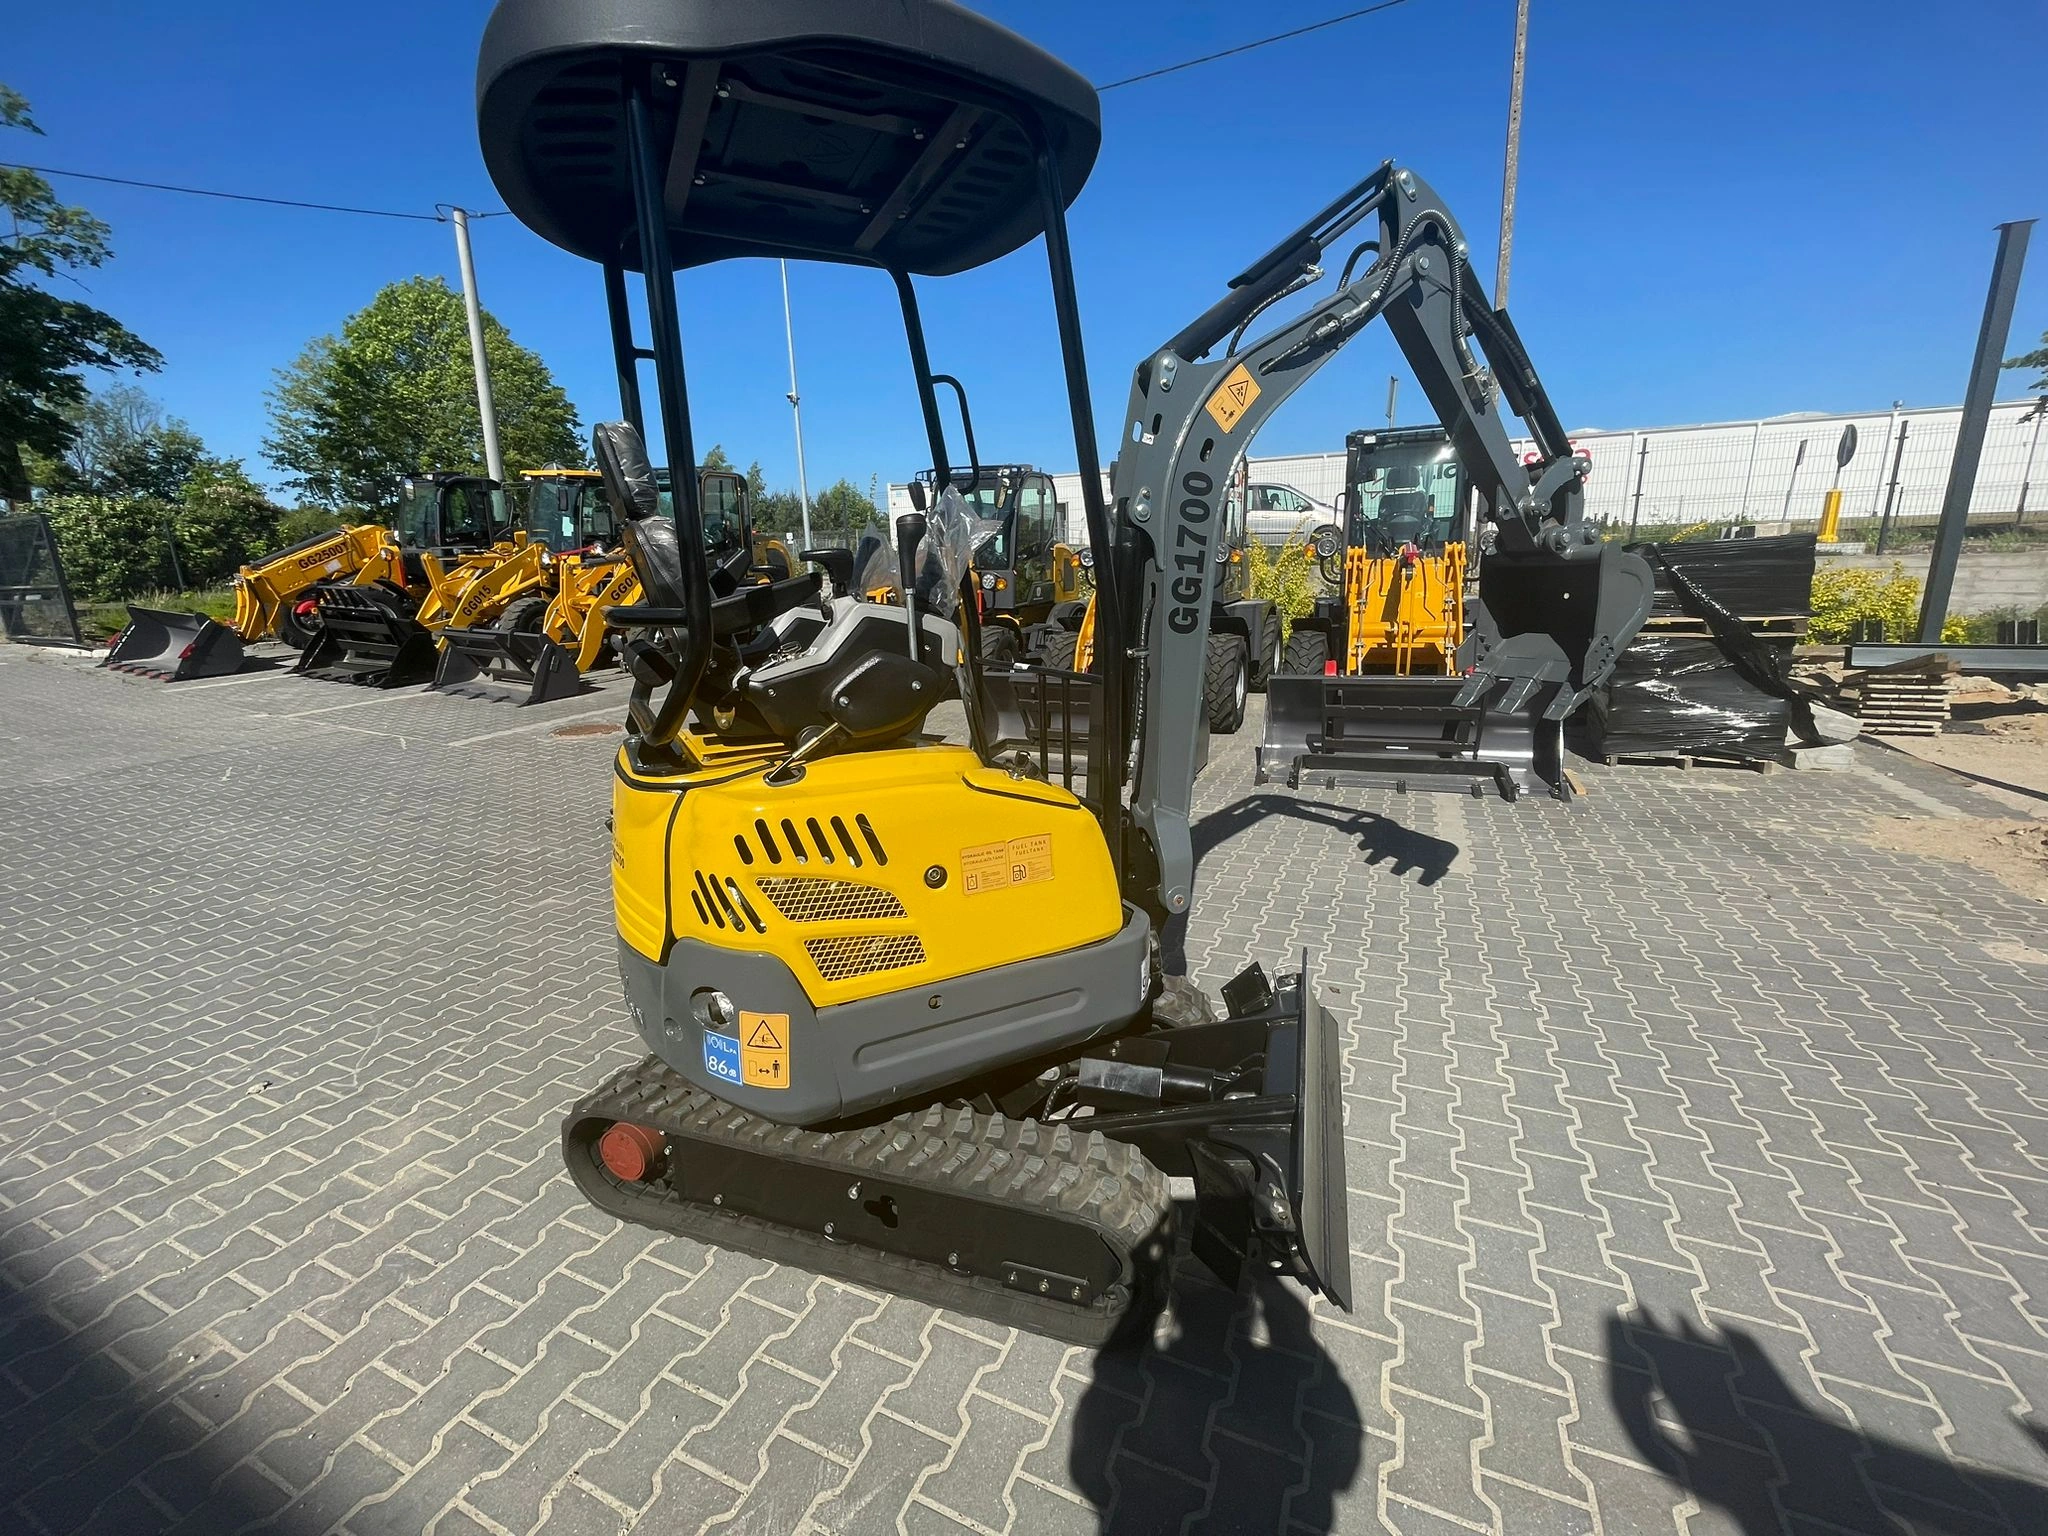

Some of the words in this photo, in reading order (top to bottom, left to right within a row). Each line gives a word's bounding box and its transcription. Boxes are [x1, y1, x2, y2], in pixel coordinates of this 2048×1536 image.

[1168, 471, 1214, 634] GG1700
[462, 584, 491, 616] GG015
[610, 571, 640, 601] GG01
[1012, 843, 1028, 851] FUEL
[1030, 839, 1047, 847] TANK
[708, 1055, 728, 1074] 86
